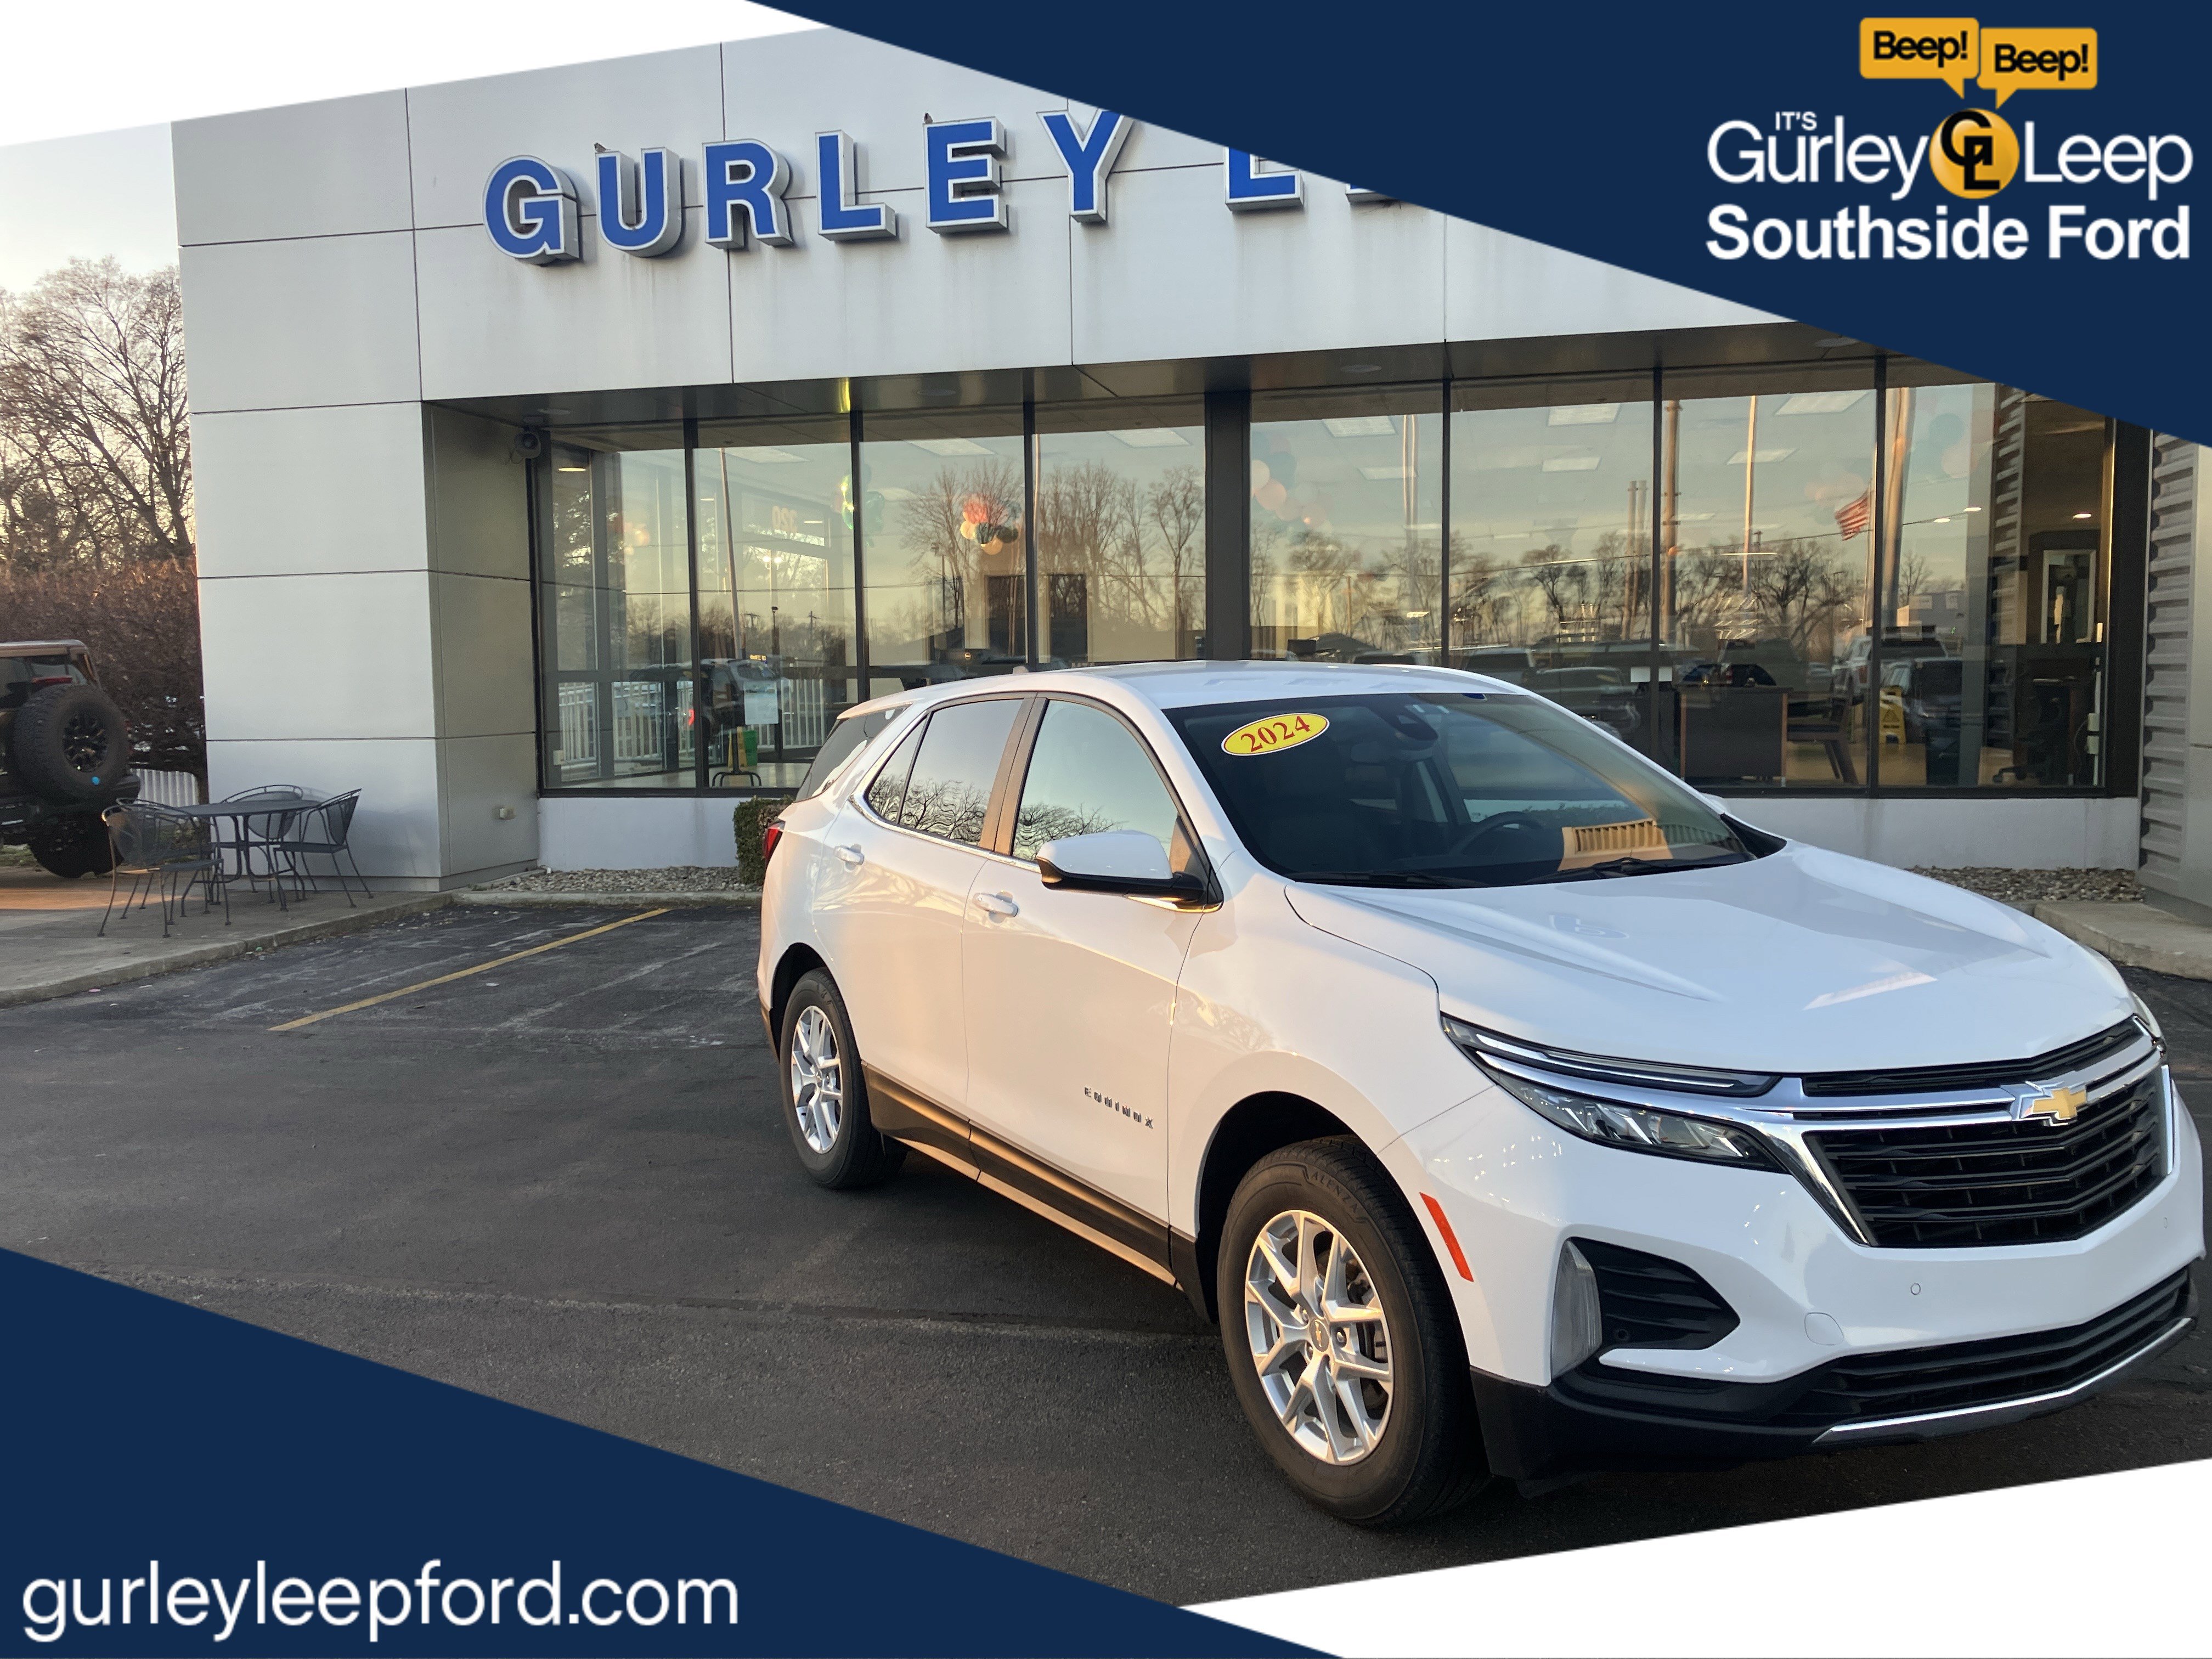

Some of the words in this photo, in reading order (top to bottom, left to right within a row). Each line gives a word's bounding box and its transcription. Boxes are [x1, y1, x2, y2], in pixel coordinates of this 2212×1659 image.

[483, 109, 1133, 266] GURLEY
[1240, 715, 1311, 752] 2024
[1084, 1085, 1153, 1129] EQUINOX
